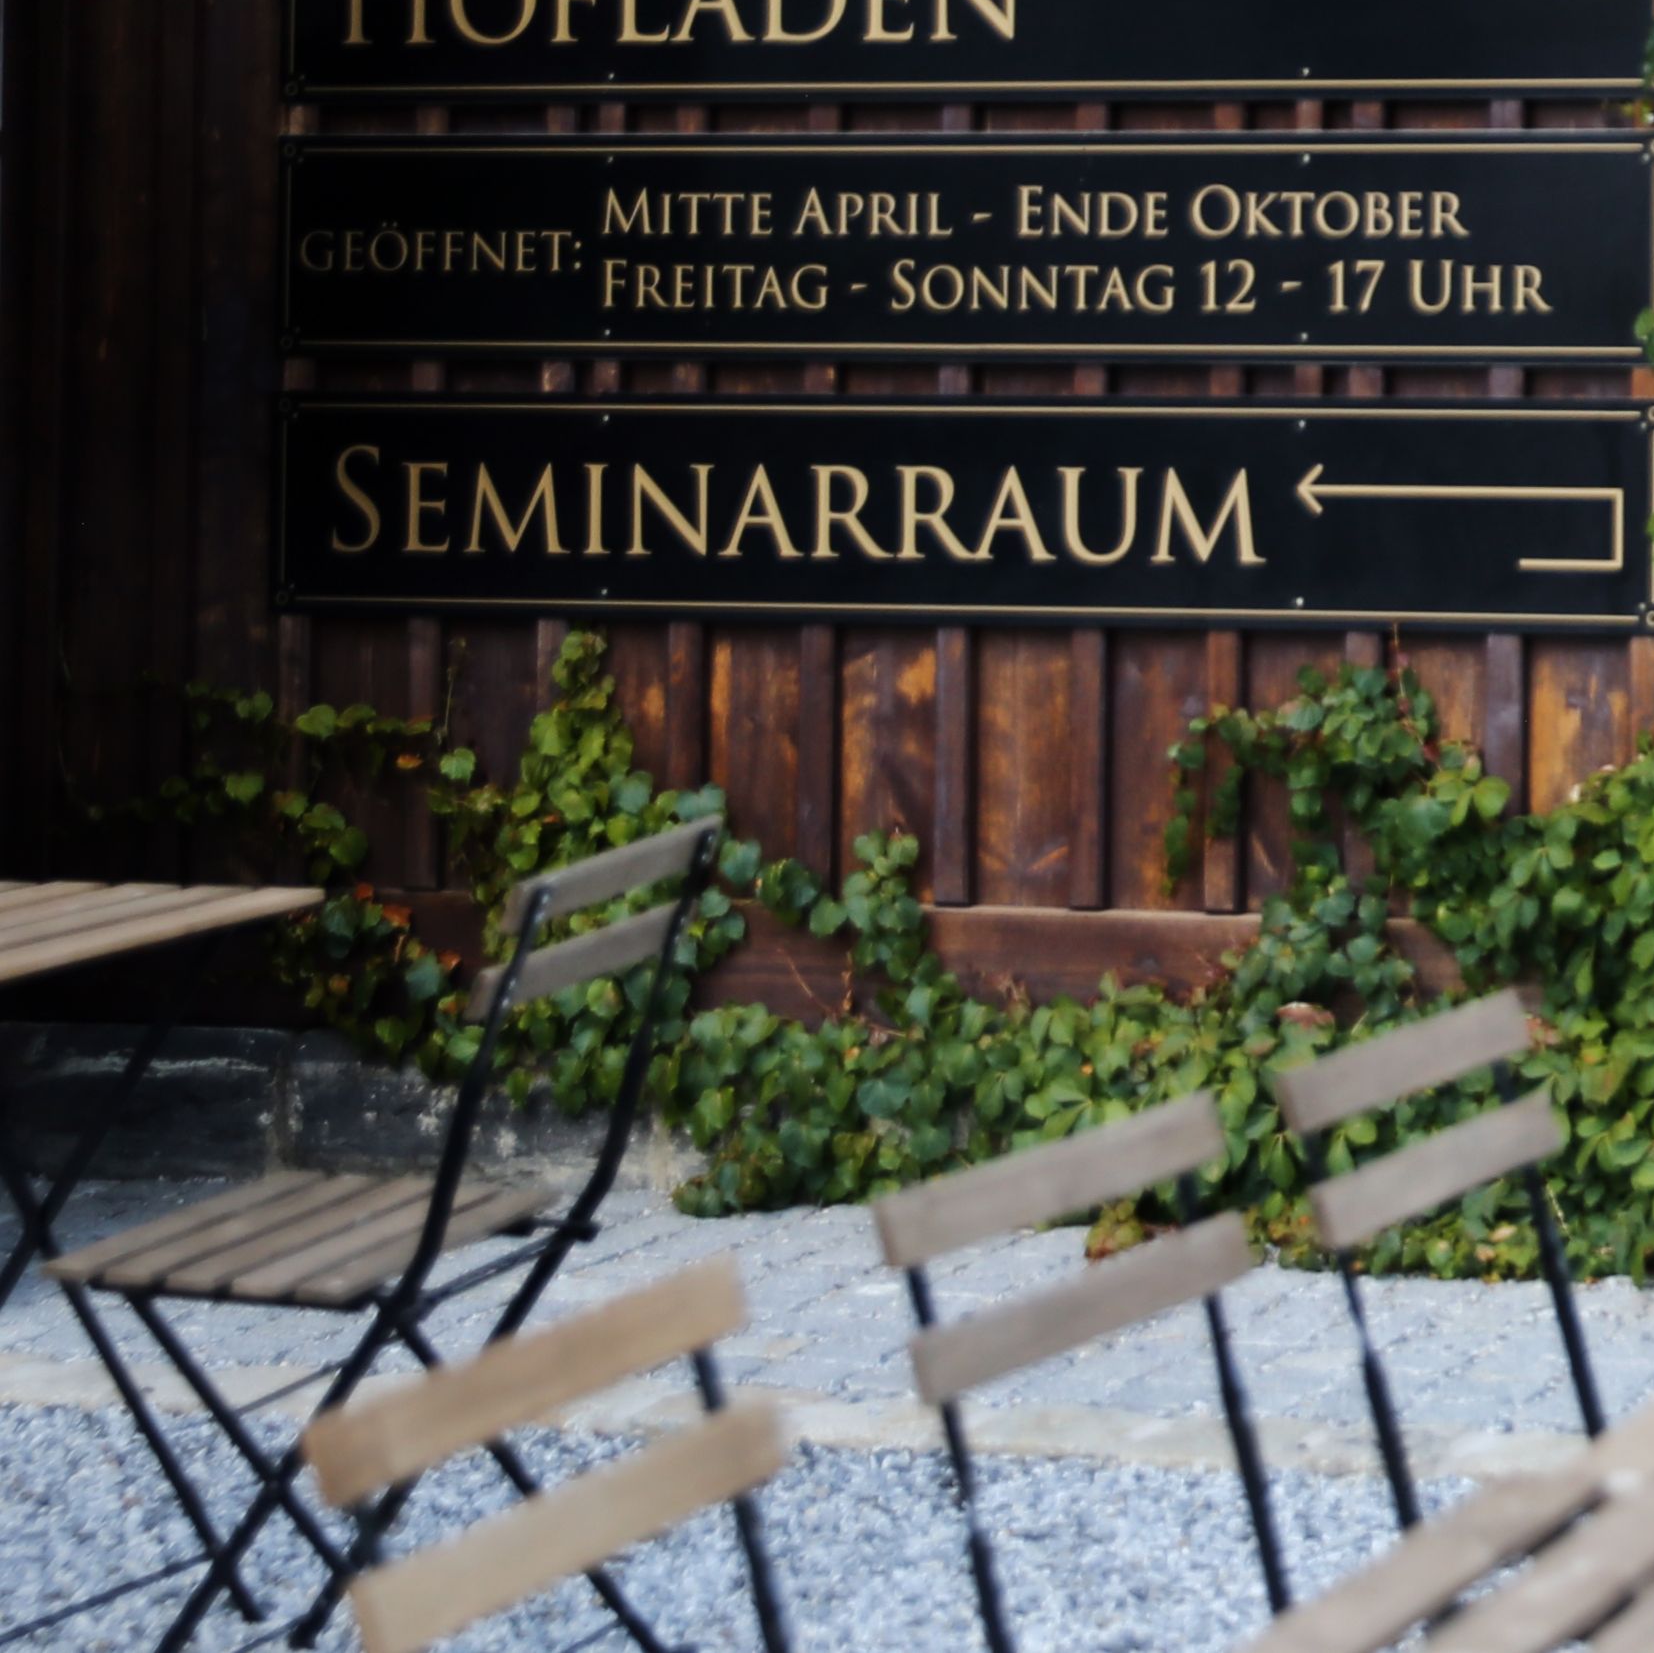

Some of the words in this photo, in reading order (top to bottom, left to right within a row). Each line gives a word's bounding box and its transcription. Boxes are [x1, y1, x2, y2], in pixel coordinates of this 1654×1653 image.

[602, 187, 773, 236] MITTE
[793, 187, 953, 237] APRIL
[1018, 185, 1168, 237] ENDE
[1190, 183, 1469, 238] OKTOBER
[301, 221, 583, 272] GEÖFFNET:
[603, 259, 828, 310] FREITAG
[891, 258, 1175, 313] SONNTAG
[1200, 258, 1256, 313] 12
[1328, 259, 1385, 313] 17
[1410, 259, 1552, 314] UHR
[331, 445, 1267, 566] SEMINARRAUM
